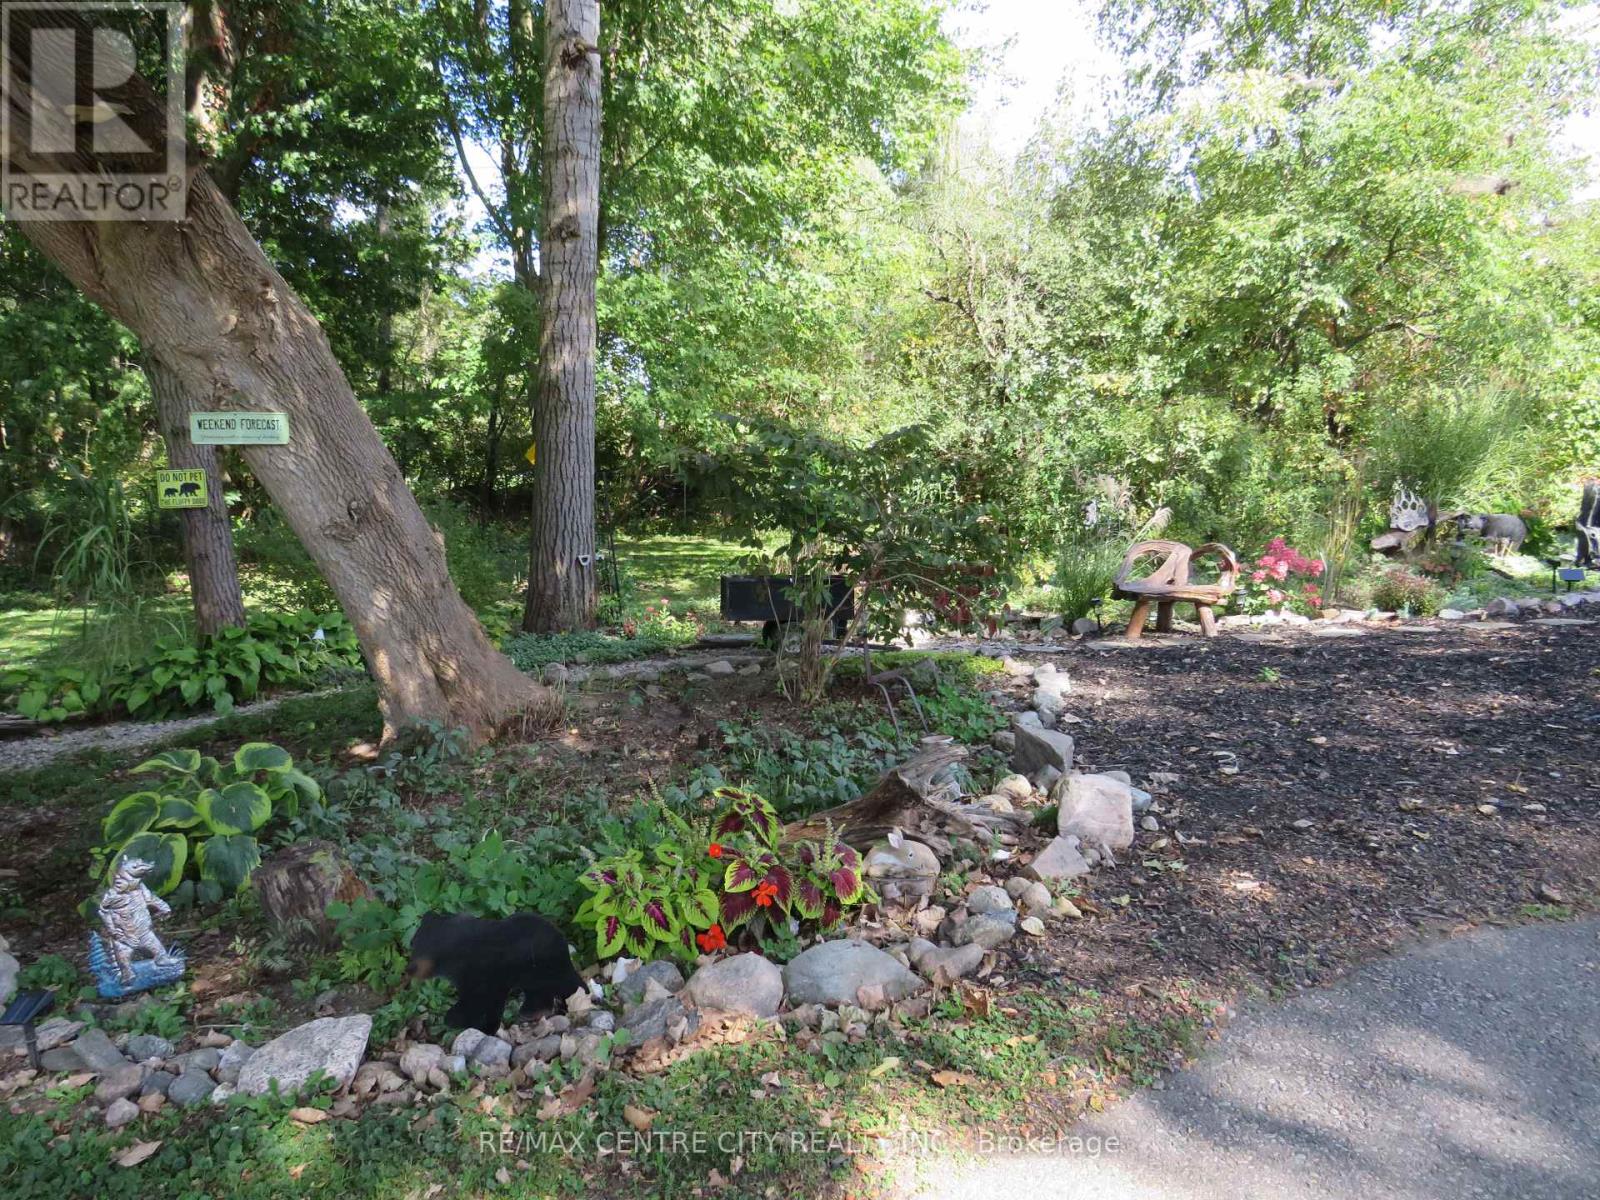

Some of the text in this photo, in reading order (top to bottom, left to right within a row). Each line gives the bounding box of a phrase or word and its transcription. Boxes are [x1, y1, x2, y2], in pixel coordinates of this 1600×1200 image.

[197, 419, 280, 430] WEEKEND FORECAST
[160, 471, 202, 482] DO NOT PET
